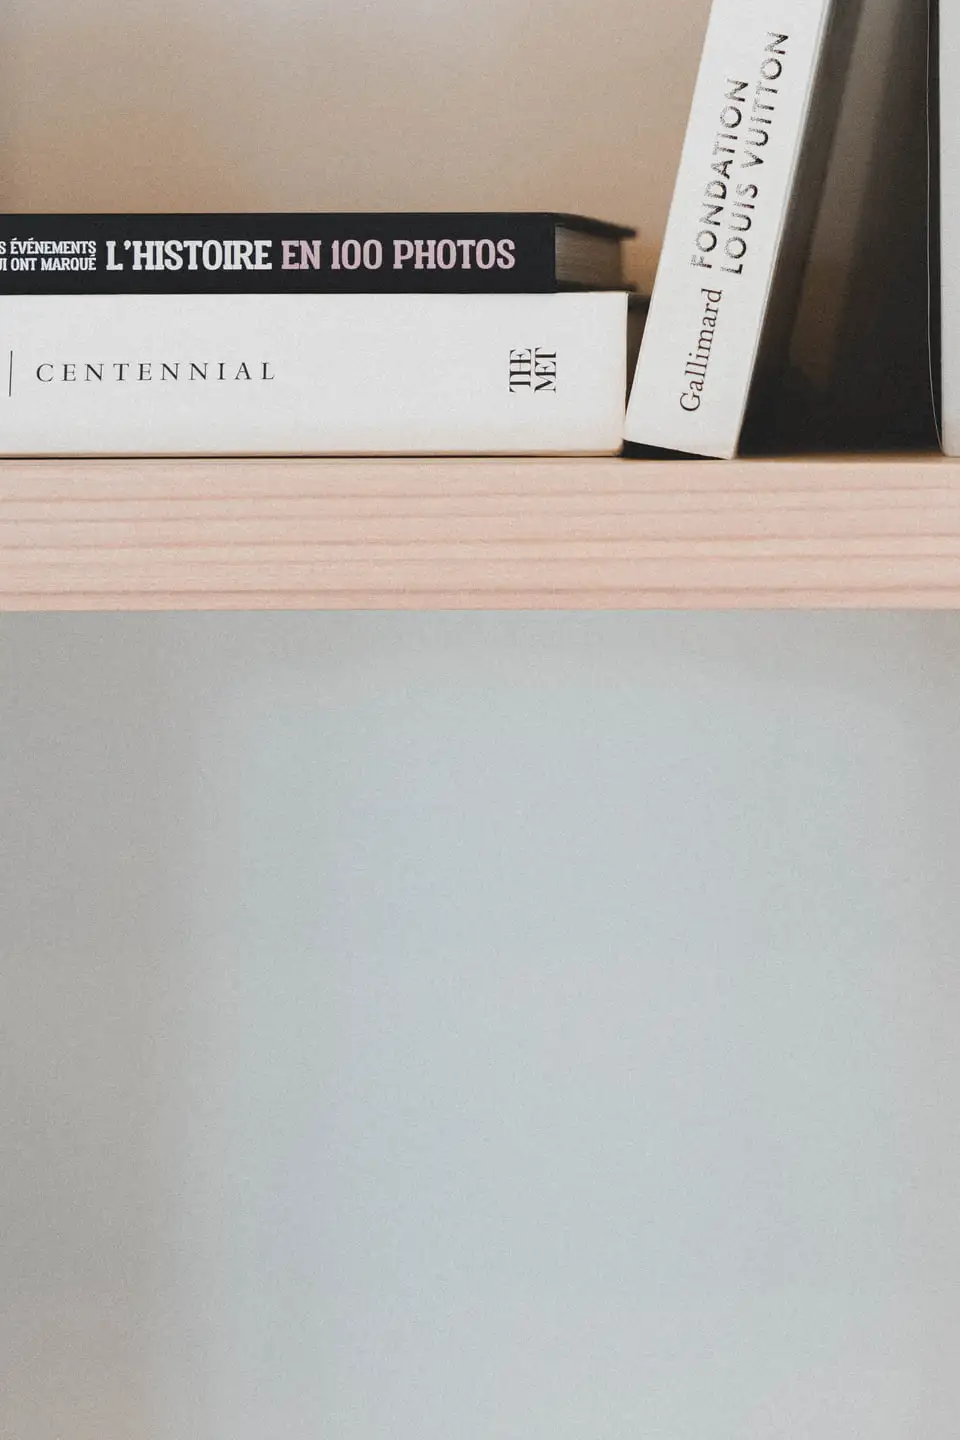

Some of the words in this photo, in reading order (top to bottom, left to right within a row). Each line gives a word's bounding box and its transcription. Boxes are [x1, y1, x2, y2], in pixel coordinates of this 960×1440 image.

[690, 79, 749, 270] FONDATION
[720, 182, 759, 276] LOUIS
[740, 31, 789, 169] VUITTON
[10, 237, 97, 255] ÉVÉNEMENTS
[10, 257, 38, 272] ONT
[40, 254, 97, 272] MARQUÉ
[105, 240, 273, 271] L’HISTOIRE
[281, 240, 322, 270] EN
[331, 239, 383, 270] 100
[392, 239, 516, 270] PHOTOS
[36, 362, 275, 382] CENTENNIAL
[509, 348, 532, 393] THE
[534, 347, 557, 393] MET
[679, 288, 723, 412] Gallimard
